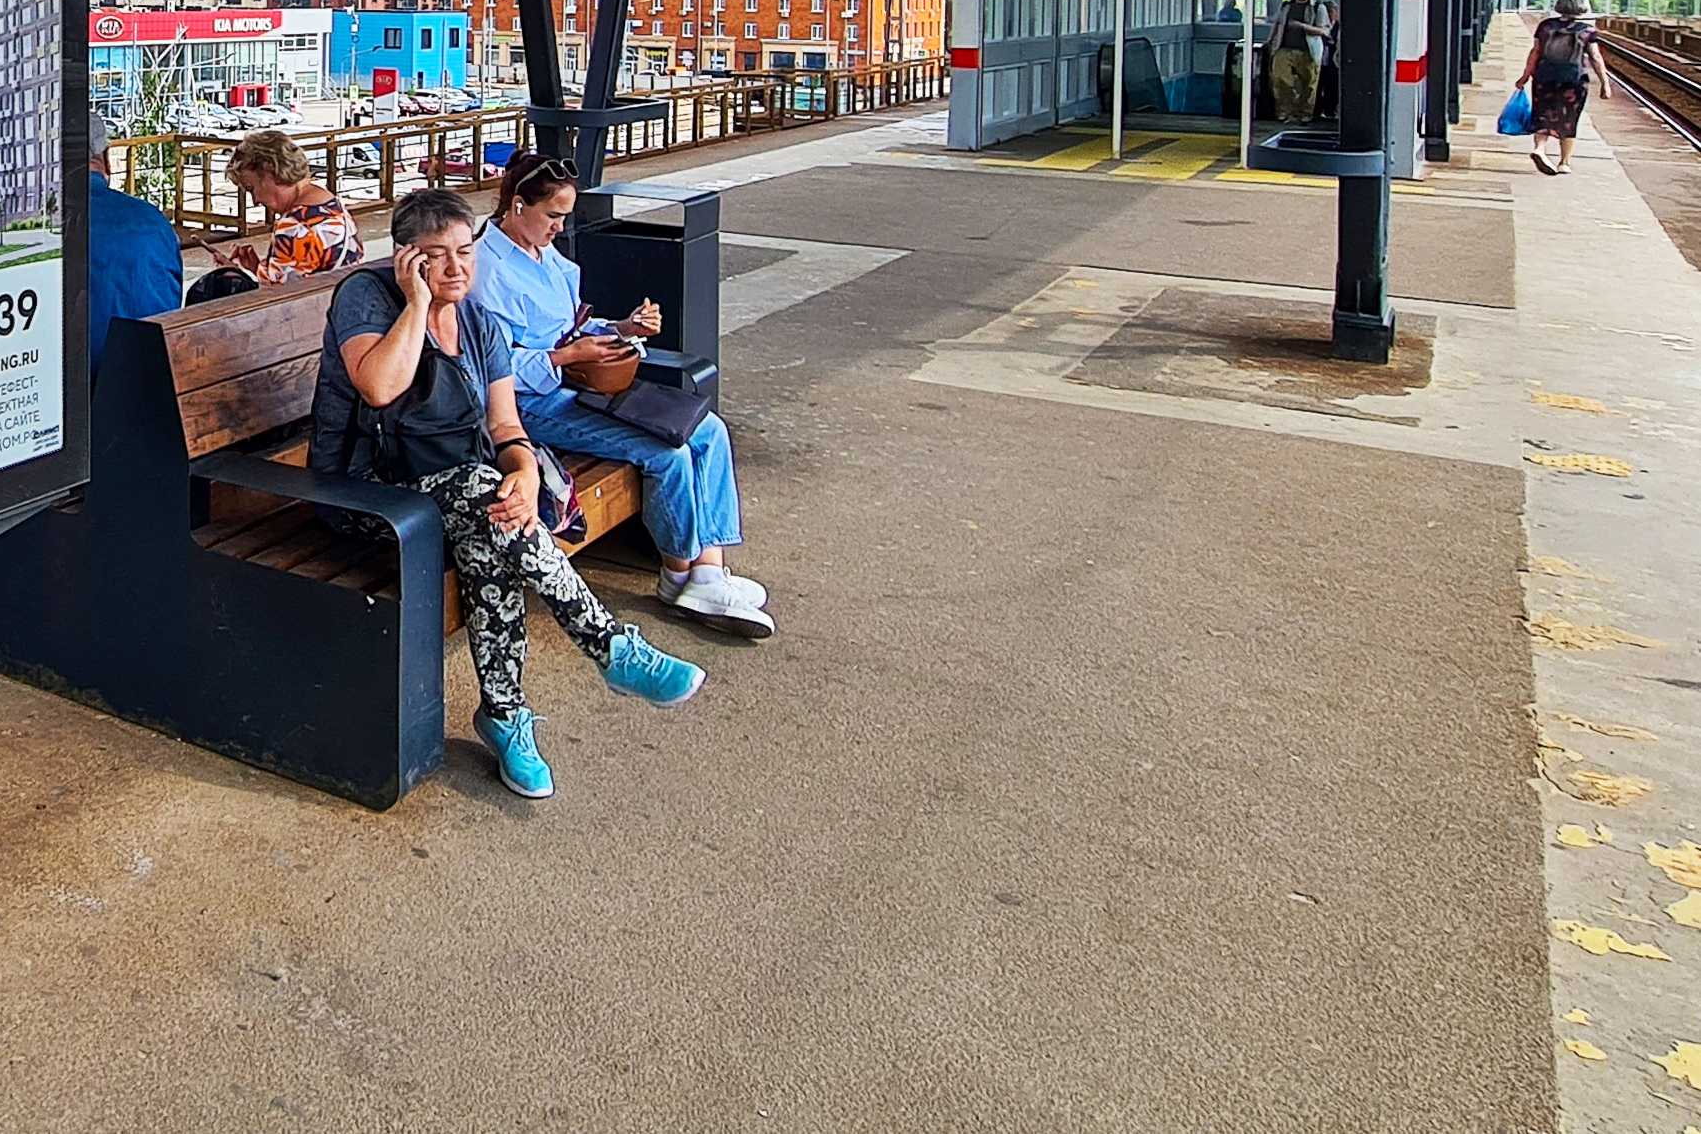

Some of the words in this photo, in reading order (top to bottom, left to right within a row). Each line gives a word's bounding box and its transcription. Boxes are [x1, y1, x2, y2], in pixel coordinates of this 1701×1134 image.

[214, 17, 232, 33] KIA
[233, 17, 273, 32] MOTORS
[4, 410, 41, 430] САЙТЕ
